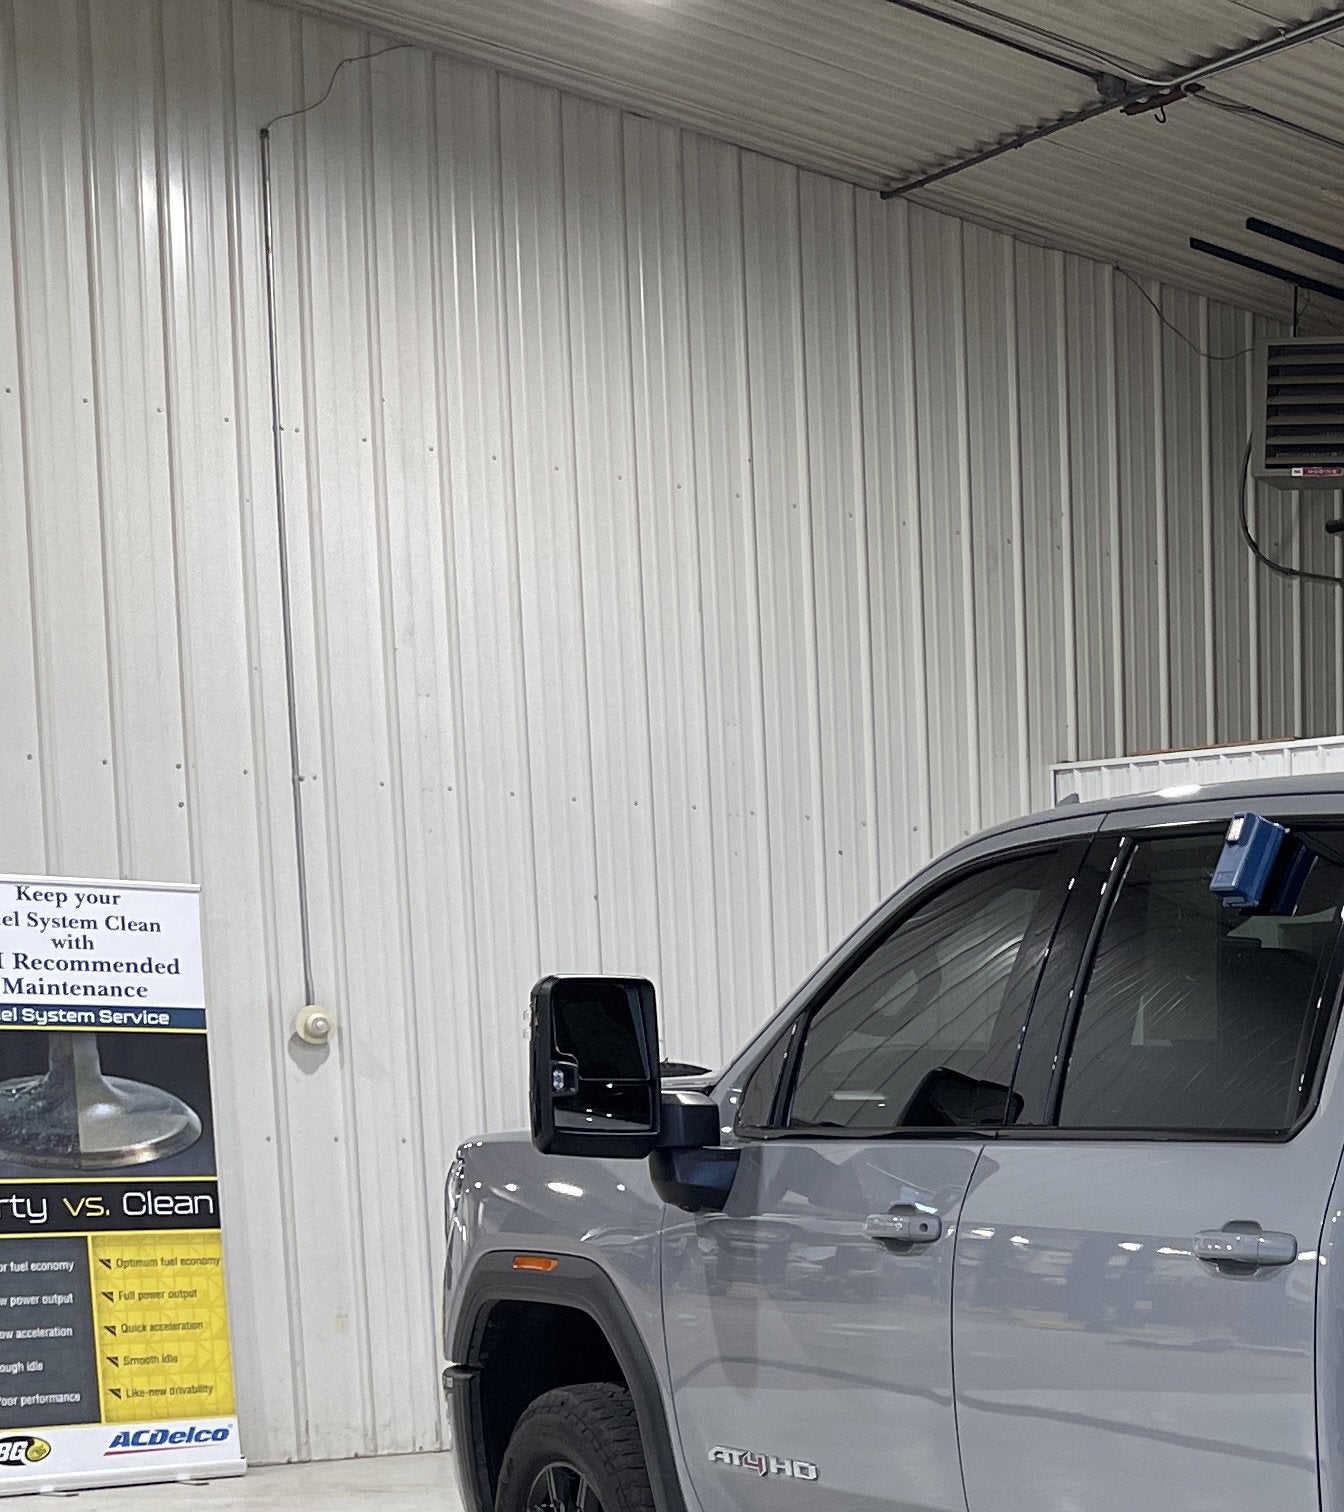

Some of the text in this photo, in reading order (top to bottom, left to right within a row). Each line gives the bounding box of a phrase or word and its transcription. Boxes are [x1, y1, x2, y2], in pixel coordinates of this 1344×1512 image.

[16, 885, 122, 909] Keep your
[0, 911, 162, 934] el System Clean
[51, 934, 95, 950] with
[13, 952, 181, 975] Recommended
[2, 977, 149, 998] Maintenance
[0, 1007, 170, 1026] el System Service
[63, 1196, 110, 1217] vs.
[122, 1190, 214, 1216] Clean
[10, 1260, 29, 1272] fuel
[30, 1261, 75, 1273] economy
[116, 1256, 220, 1270] Optimum fuel economy
[10, 1295, 40, 1308] power
[42, 1292, 74, 1306] output
[118, 1289, 198, 1302] Full power output
[15, 1326, 73, 1339] acceleration
[121, 1321, 204, 1334] Quick acceleration
[26, 1360, 44, 1372] idle
[123, 1354, 178, 1366] Smooth idle
[0, 1393, 81, 1408] oor performance
[109, 1425, 230, 1448] ACDelco
